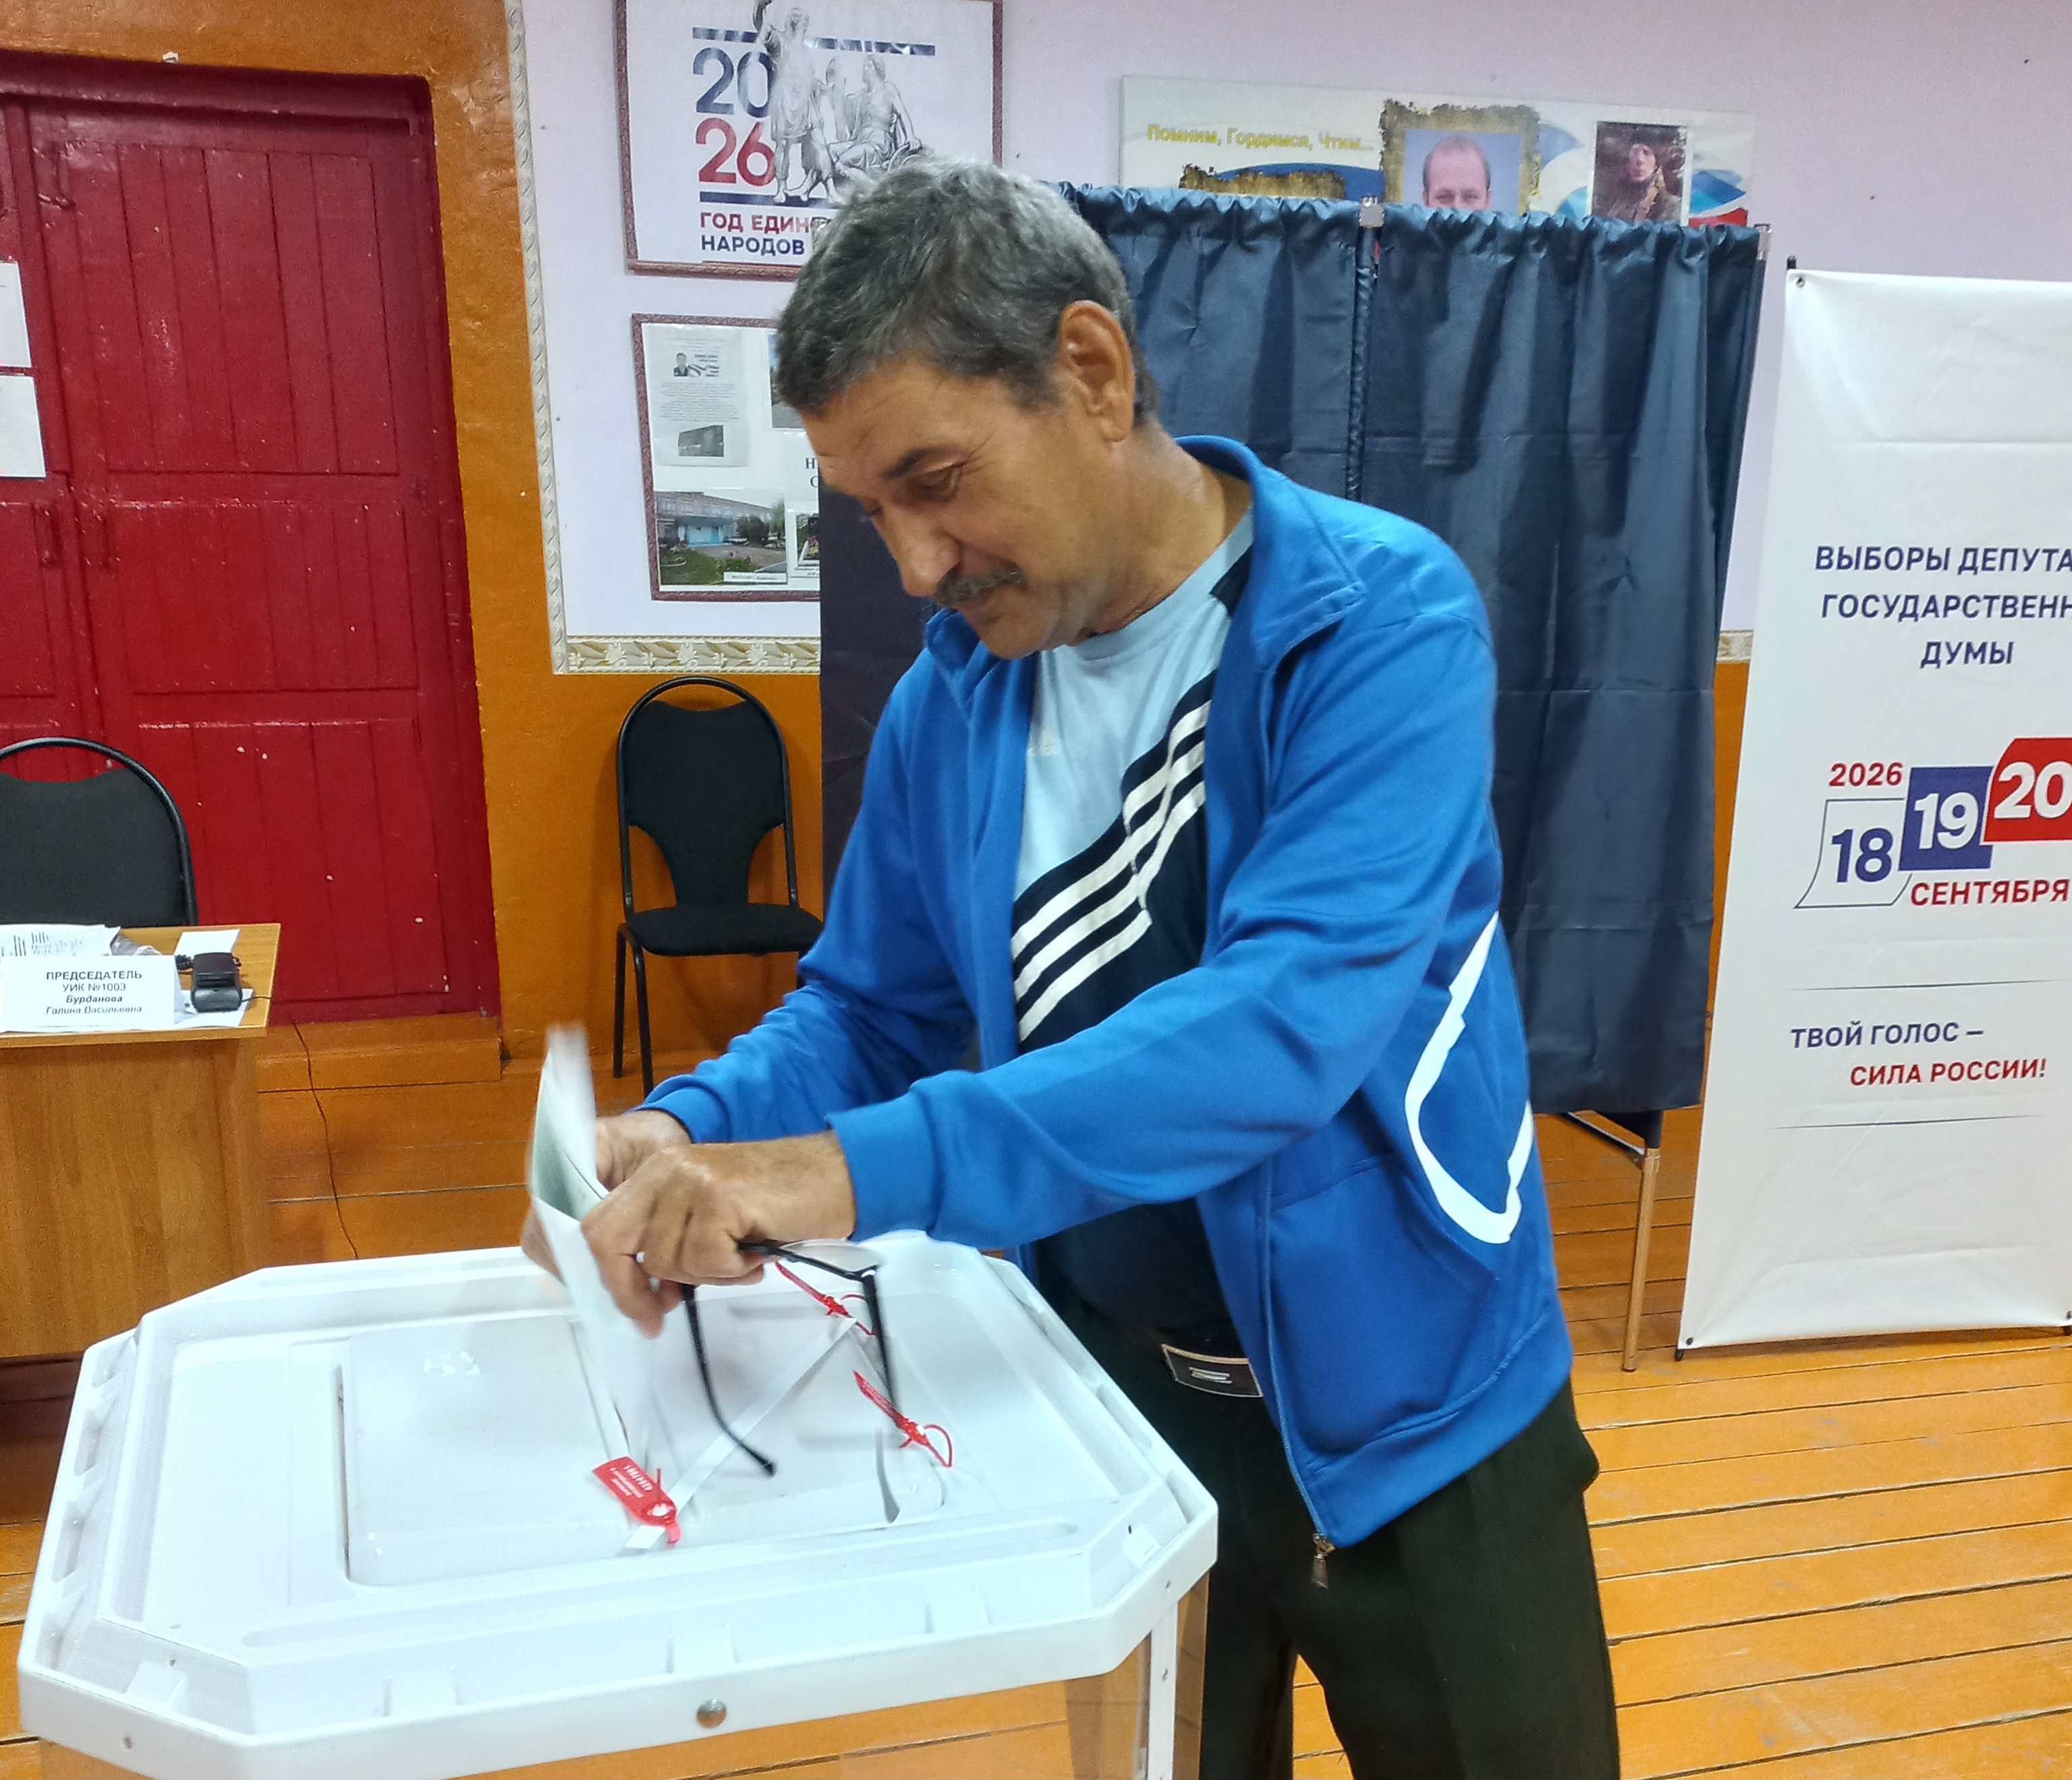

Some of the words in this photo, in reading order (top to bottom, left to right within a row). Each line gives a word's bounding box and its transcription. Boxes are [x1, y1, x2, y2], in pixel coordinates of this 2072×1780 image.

[693, 48, 775, 118] 20
[1147, 123, 1222, 146] Помним,
[696, 117, 776, 187] 26
[700, 212, 744, 233] ГОД
[701, 235, 805, 256] НАРОДОВ
[1815, 546, 1951, 571] ВЫБОРЫ
[1958, 547, 2072, 576] ДЕПУТА
[1920, 641, 2014, 669] ДУМЫ
[1828, 762, 1903, 787] 2026
[1831, 827, 1894, 883] 18
[1913, 791, 1979, 850] 19
[1994, 760, 2072, 820] 20
[1911, 878, 2070, 907] СЕНТЯБРЯ
[47, 970, 142, 982] ПРЕДСЕДАТЕЛЬ
[63, 983, 84, 993] УИК
[46, 1006, 81, 1015] Галина
[66, 995, 123, 1005] Бурданова
[1791, 1020, 1863, 1049] ТВОЙ
[1870, 1022, 1959, 1045] ГОЛОС
[1850, 1064, 1922, 1086] СИЛА
[1930, 1058, 2047, 1082] РОССИИ!
